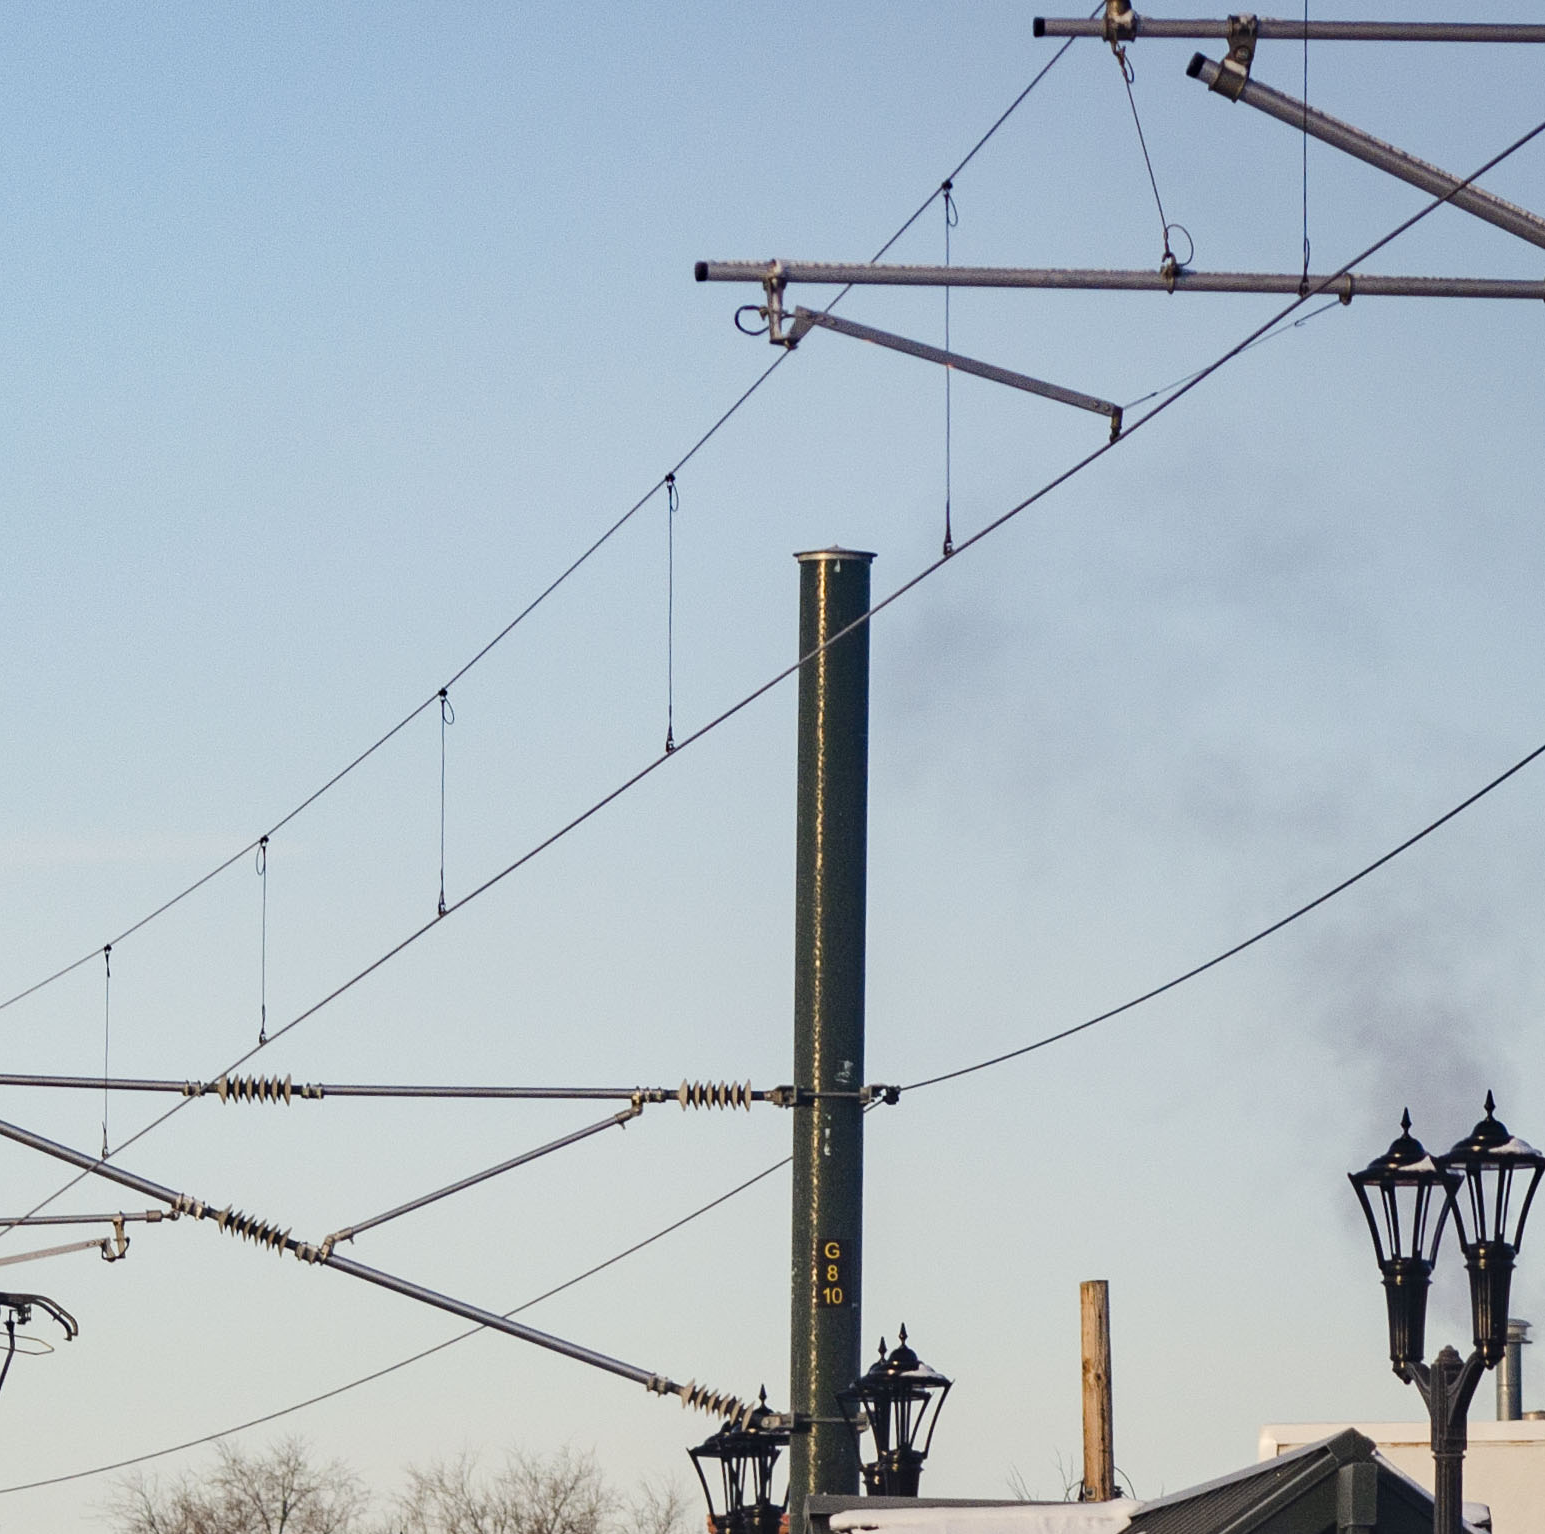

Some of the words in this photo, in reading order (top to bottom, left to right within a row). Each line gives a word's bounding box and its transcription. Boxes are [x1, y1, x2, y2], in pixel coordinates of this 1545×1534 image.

[824, 1242, 840, 1259] G
[827, 1264, 838, 1282] 8
[822, 1287, 843, 1305] 10
